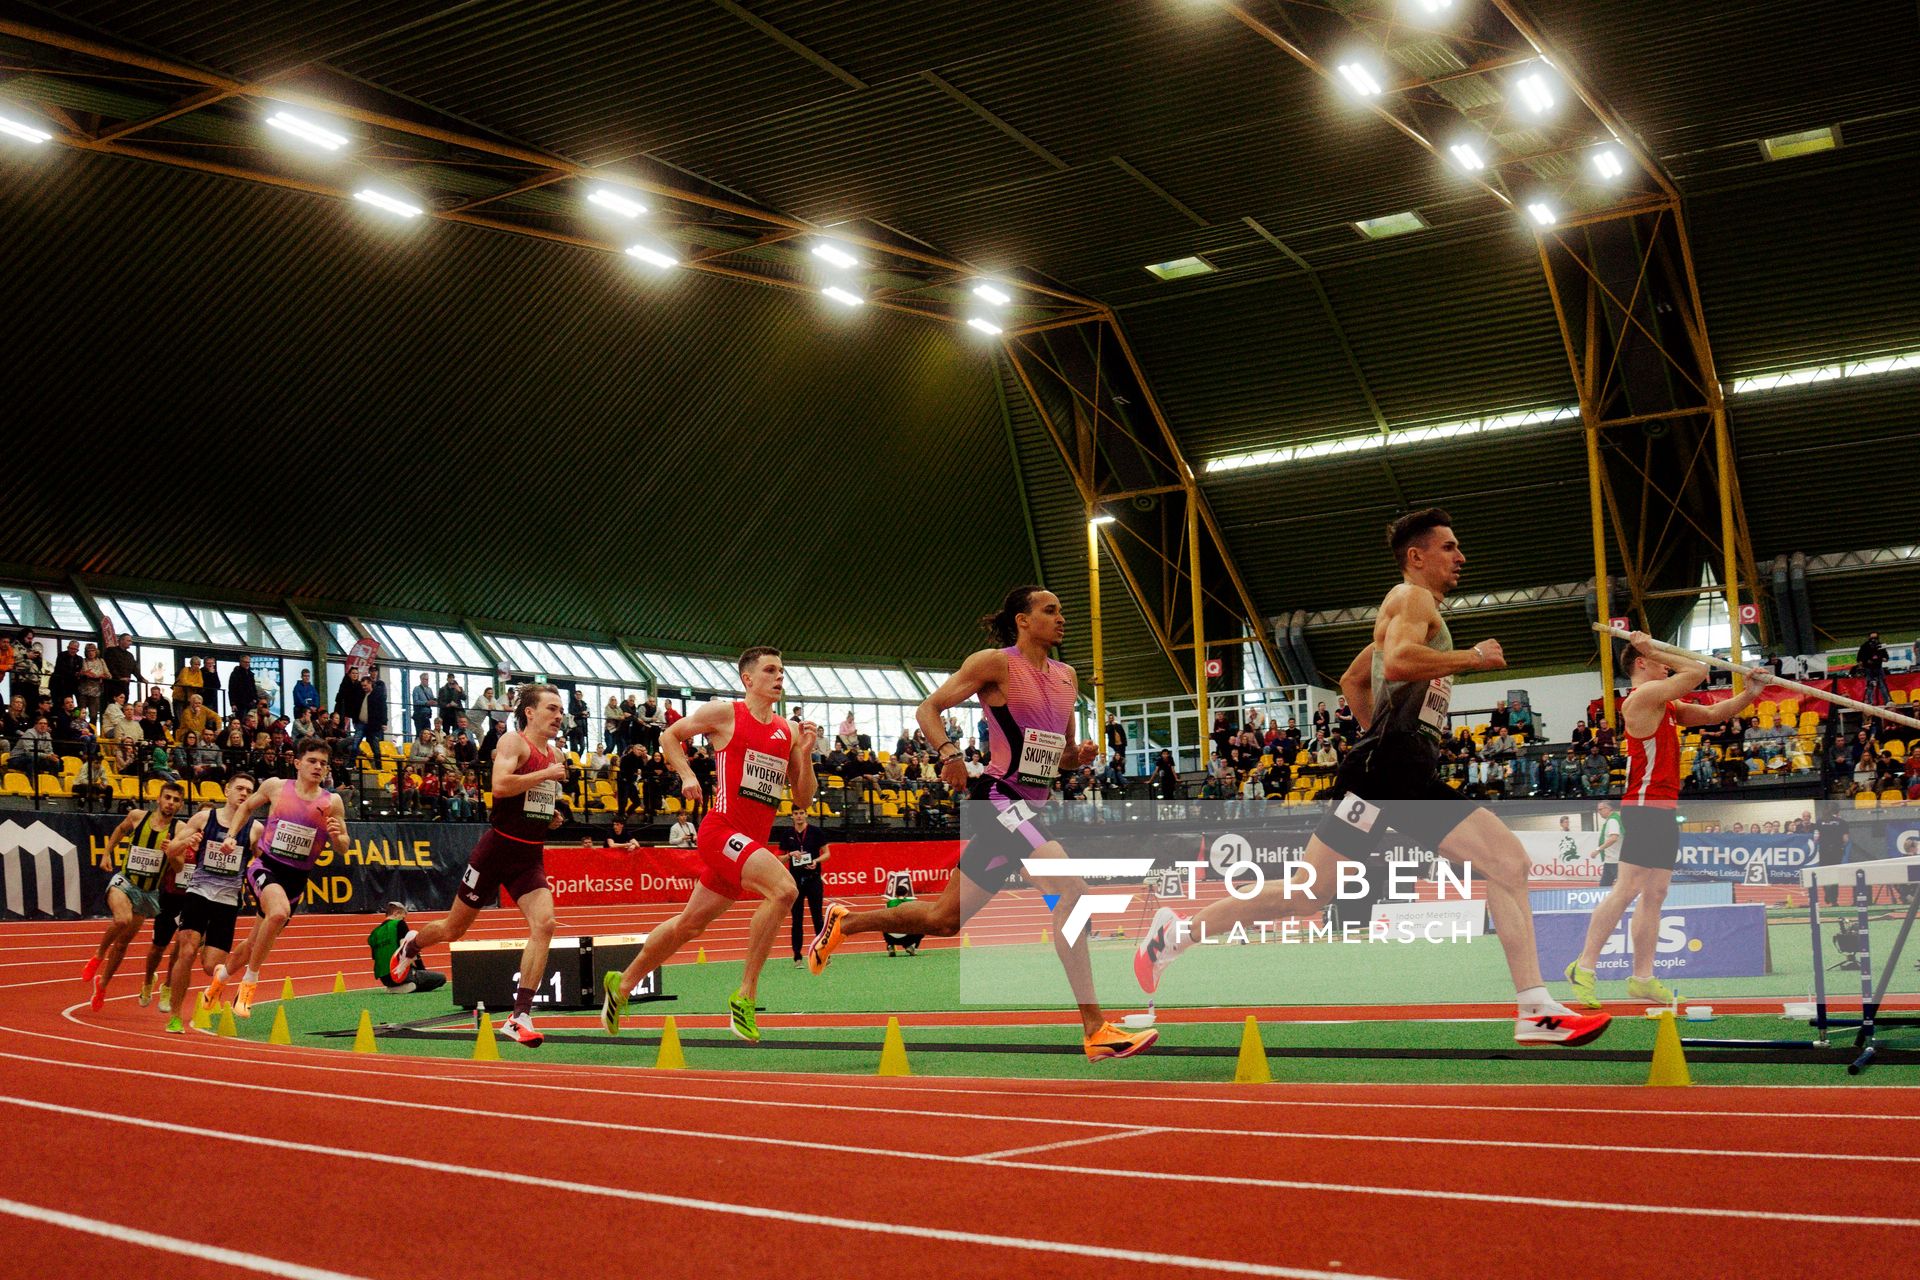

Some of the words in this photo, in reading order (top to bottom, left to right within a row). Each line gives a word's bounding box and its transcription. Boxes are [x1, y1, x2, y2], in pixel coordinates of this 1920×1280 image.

[1207, 661, 1220, 675] Q
[1040, 765, 1052, 777] 174
[742, 789, 767, 801] DORTMUND
[757, 781, 773, 795] 209
[1006, 804, 1024, 822] 7
[1346, 800, 1366, 824] 8
[276, 831, 312, 849] SIERADZKI
[728, 838, 744, 852] 6
[286, 844, 298, 853] 172
[343, 839, 433, 867] HALLE
[1255, 846, 1289, 863] Half
[1384, 846, 1404, 863] all
[1408, 846, 1434, 863] the
[208, 851, 238, 864] OESTER
[464, 869, 472, 883] 4
[1749, 865, 1763, 882] 3
[545, 874, 634, 898] Sparkasse
[1166, 876, 1178, 894] 5
[1426, 910, 1462, 921] Meeting
